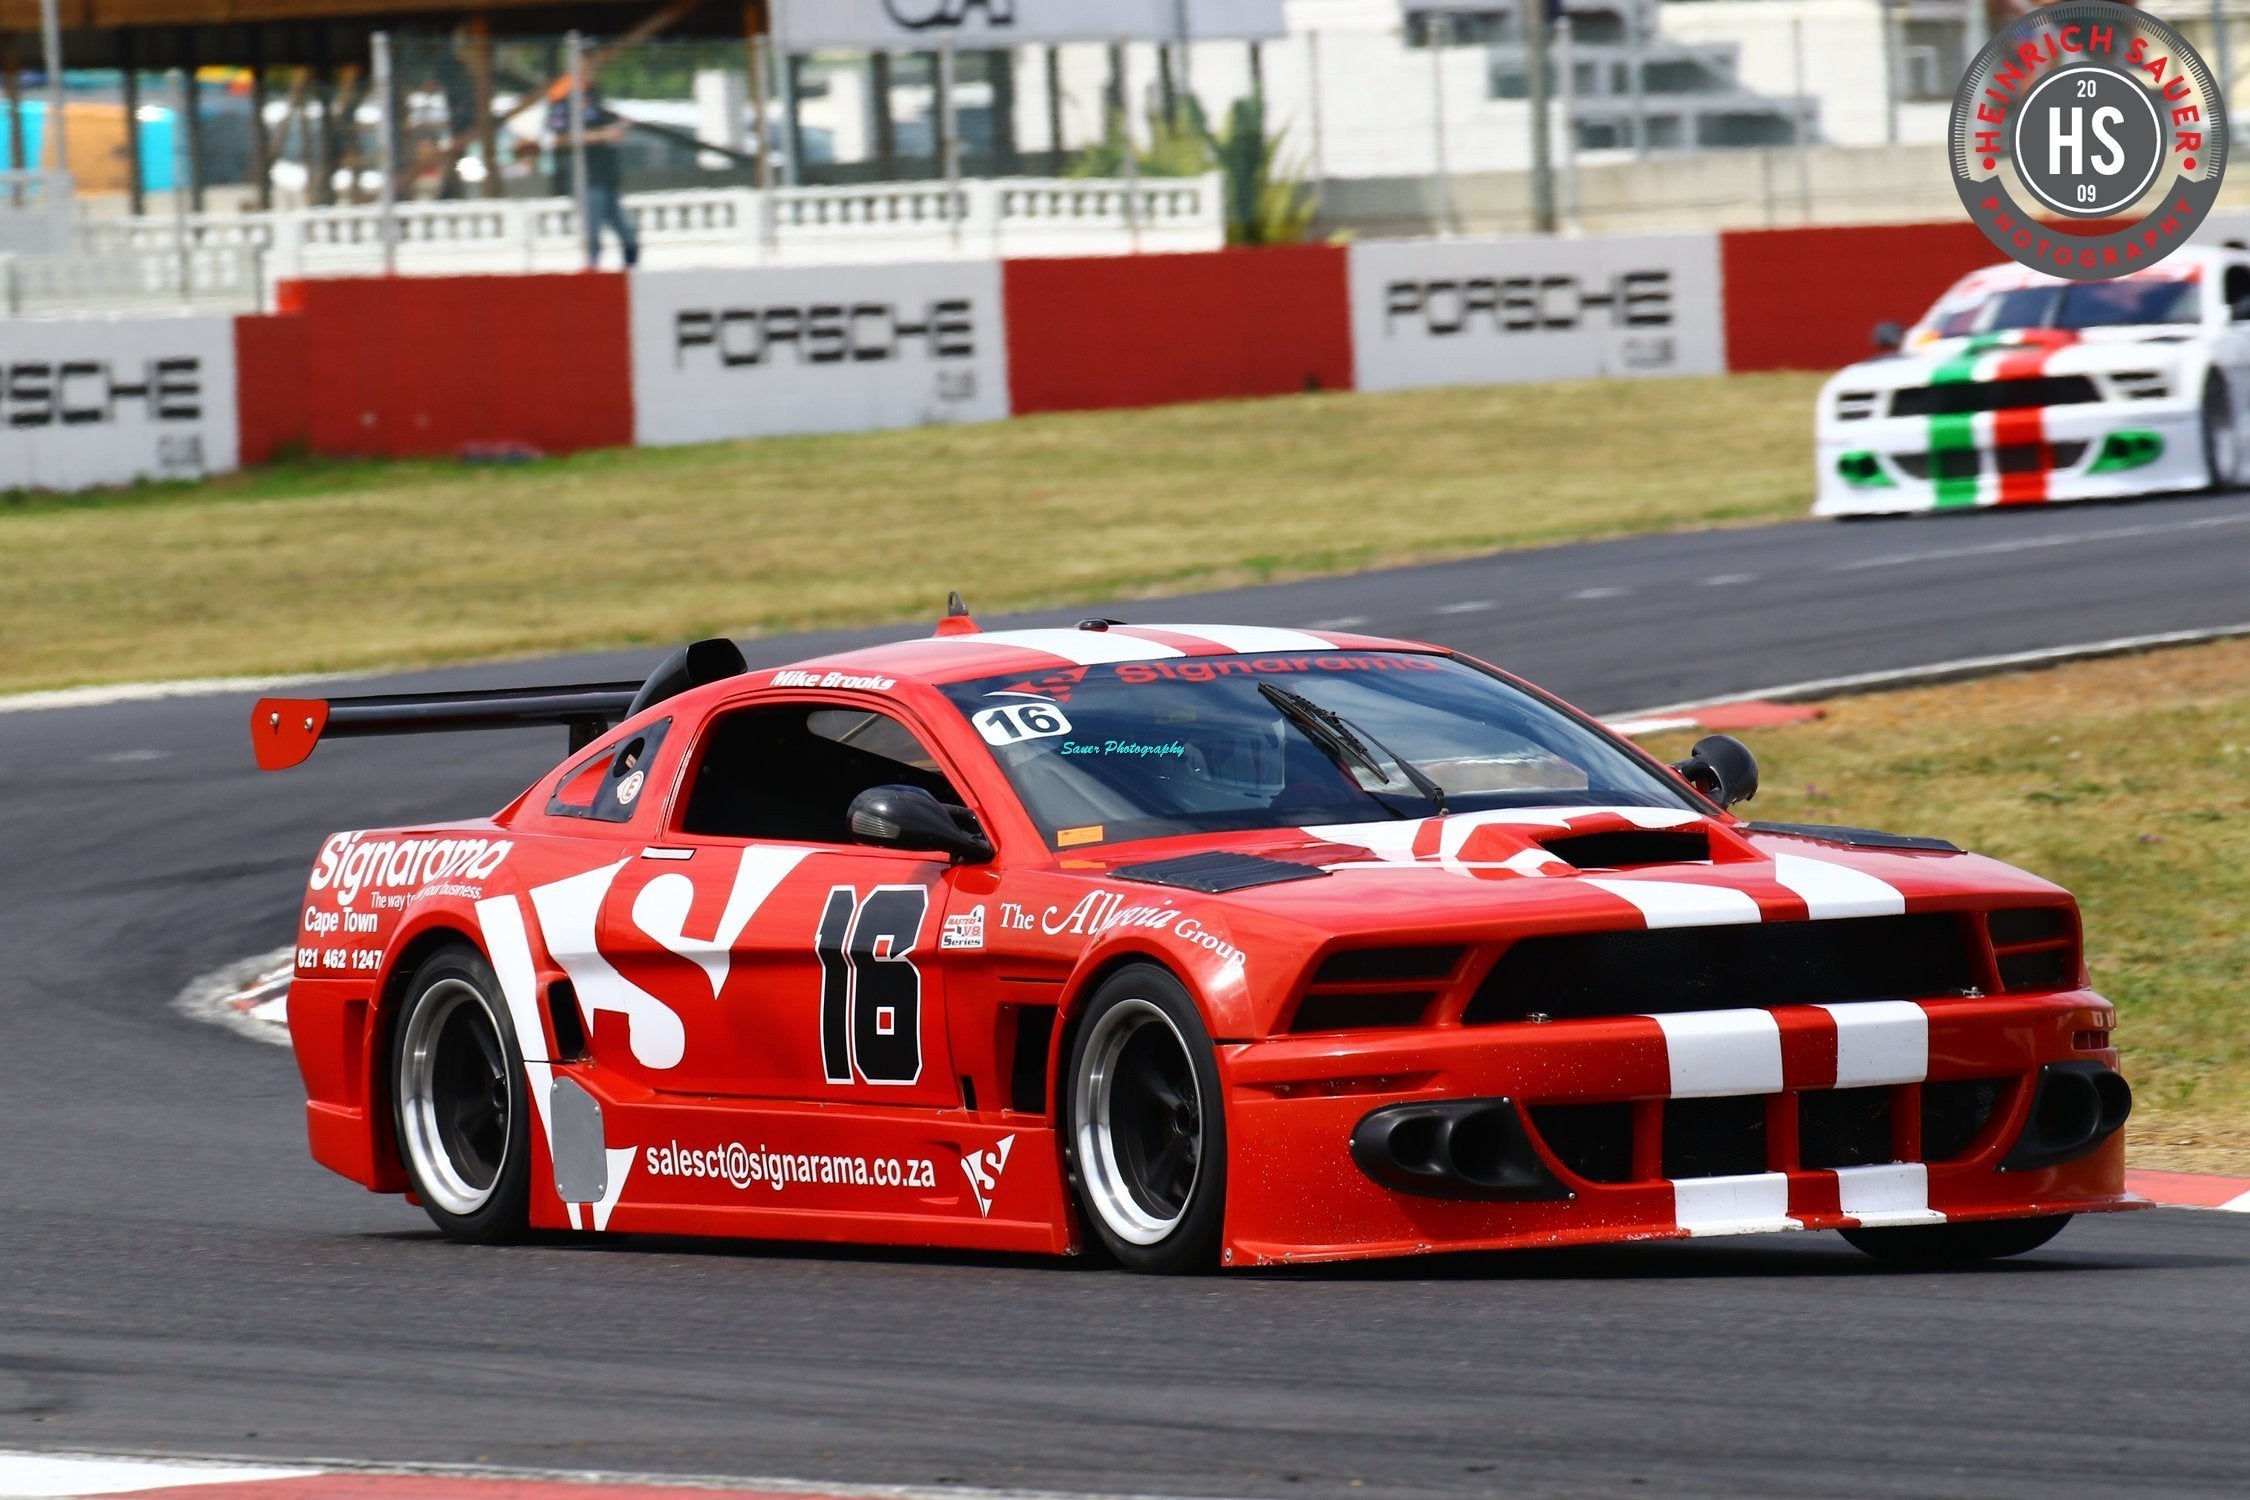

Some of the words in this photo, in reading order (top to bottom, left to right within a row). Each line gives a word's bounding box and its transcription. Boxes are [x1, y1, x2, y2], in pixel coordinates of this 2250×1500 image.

[1385, 269, 1673, 338] PORSCHE
[675, 299, 974, 370] PORSCHE
[0, 357, 201, 428] SCHE
[769, 670, 822, 688] Mike
[819, 671, 898, 691] Brooks
[1115, 654, 1443, 684] Signarama
[985, 705, 1061, 739] 16
[310, 831, 515, 906] Signarama
[371, 891, 387, 909] The
[387, 895, 406, 912] way
[304, 905, 340, 938] Cape
[342, 906, 379, 933] Town
[963, 925, 981, 937] V8
[1000, 902, 1035, 931] The
[1174, 918, 1247, 968] Group
[943, 935, 981, 946] Series
[297, 948, 319, 969] 021
[322, 949, 347, 969] 462
[351, 949, 383, 970] 1247
[815, 884, 930, 1086] 16
[646, 1139, 937, 1191] salesct@signarama.co.za
